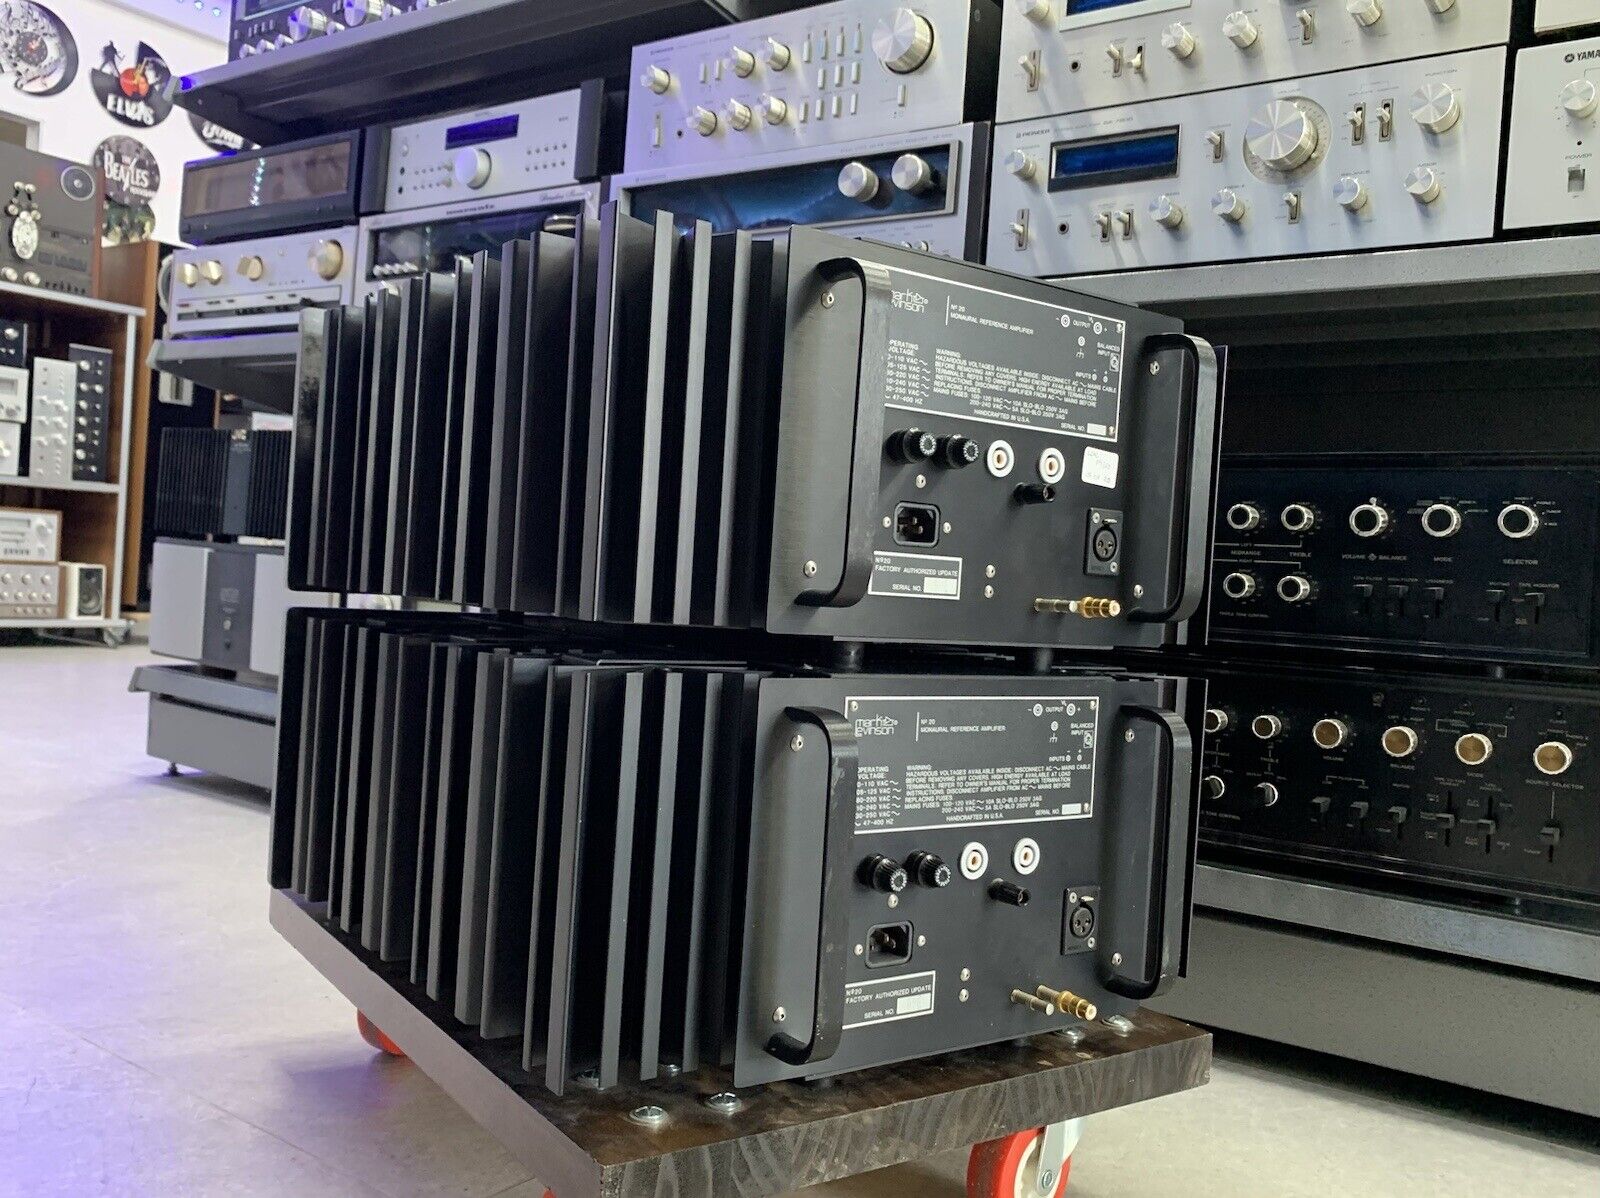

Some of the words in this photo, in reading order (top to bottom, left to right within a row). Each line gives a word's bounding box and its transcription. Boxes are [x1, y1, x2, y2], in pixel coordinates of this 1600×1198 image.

[951, 312, 978, 323] MONAURAL
[979, 318, 1008, 330] REFERENCE
[1009, 324, 1034, 335] AMPLIFIER
[1073, 320, 1091, 329] OUTPUT
[889, 339, 918, 351] PERATING
[936, 355, 967, 366] HAZARDOUS
[996, 366, 1022, 376] AVAILABLE
[1042, 374, 1071, 385] DISCONNECT
[974, 409, 1010, 420] HANDCRAFTED
[875, 565, 901, 573] FACTORY
[903, 567, 937, 575] AUTHORIZED
[855, 714, 883, 727] mark
[946, 814, 983, 822] HANDCRAFTED
[845, 994, 873, 1004] FACTORY
[875, 988, 910, 999] AUTHORIZED
[910, 985, 931, 994] UPDATE
[864, 1010, 884, 1019] SERIAL
